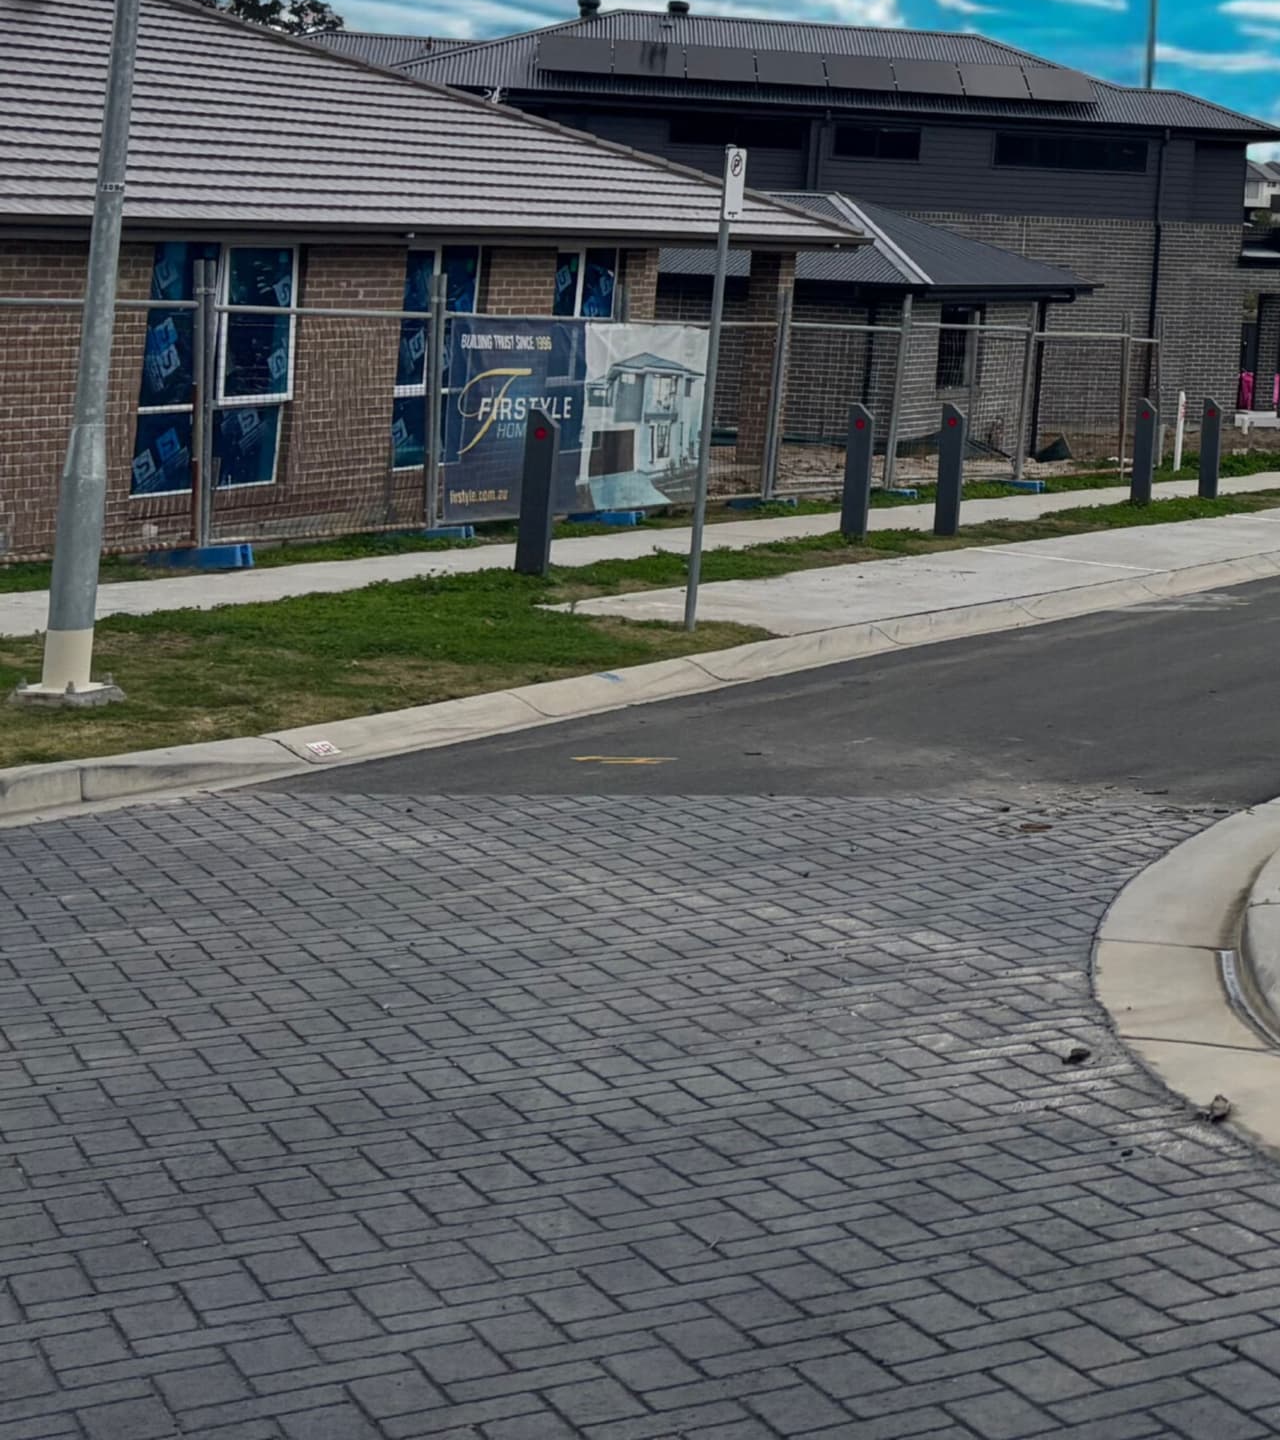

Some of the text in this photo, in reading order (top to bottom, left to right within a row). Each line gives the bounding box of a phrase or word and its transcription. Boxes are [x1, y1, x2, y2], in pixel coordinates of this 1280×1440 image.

[461, 334, 492, 349] BUILDING
[494, 335, 515, 350] TRUST
[516, 336, 535, 350] SINCE
[496, 421, 528, 439] HOM
